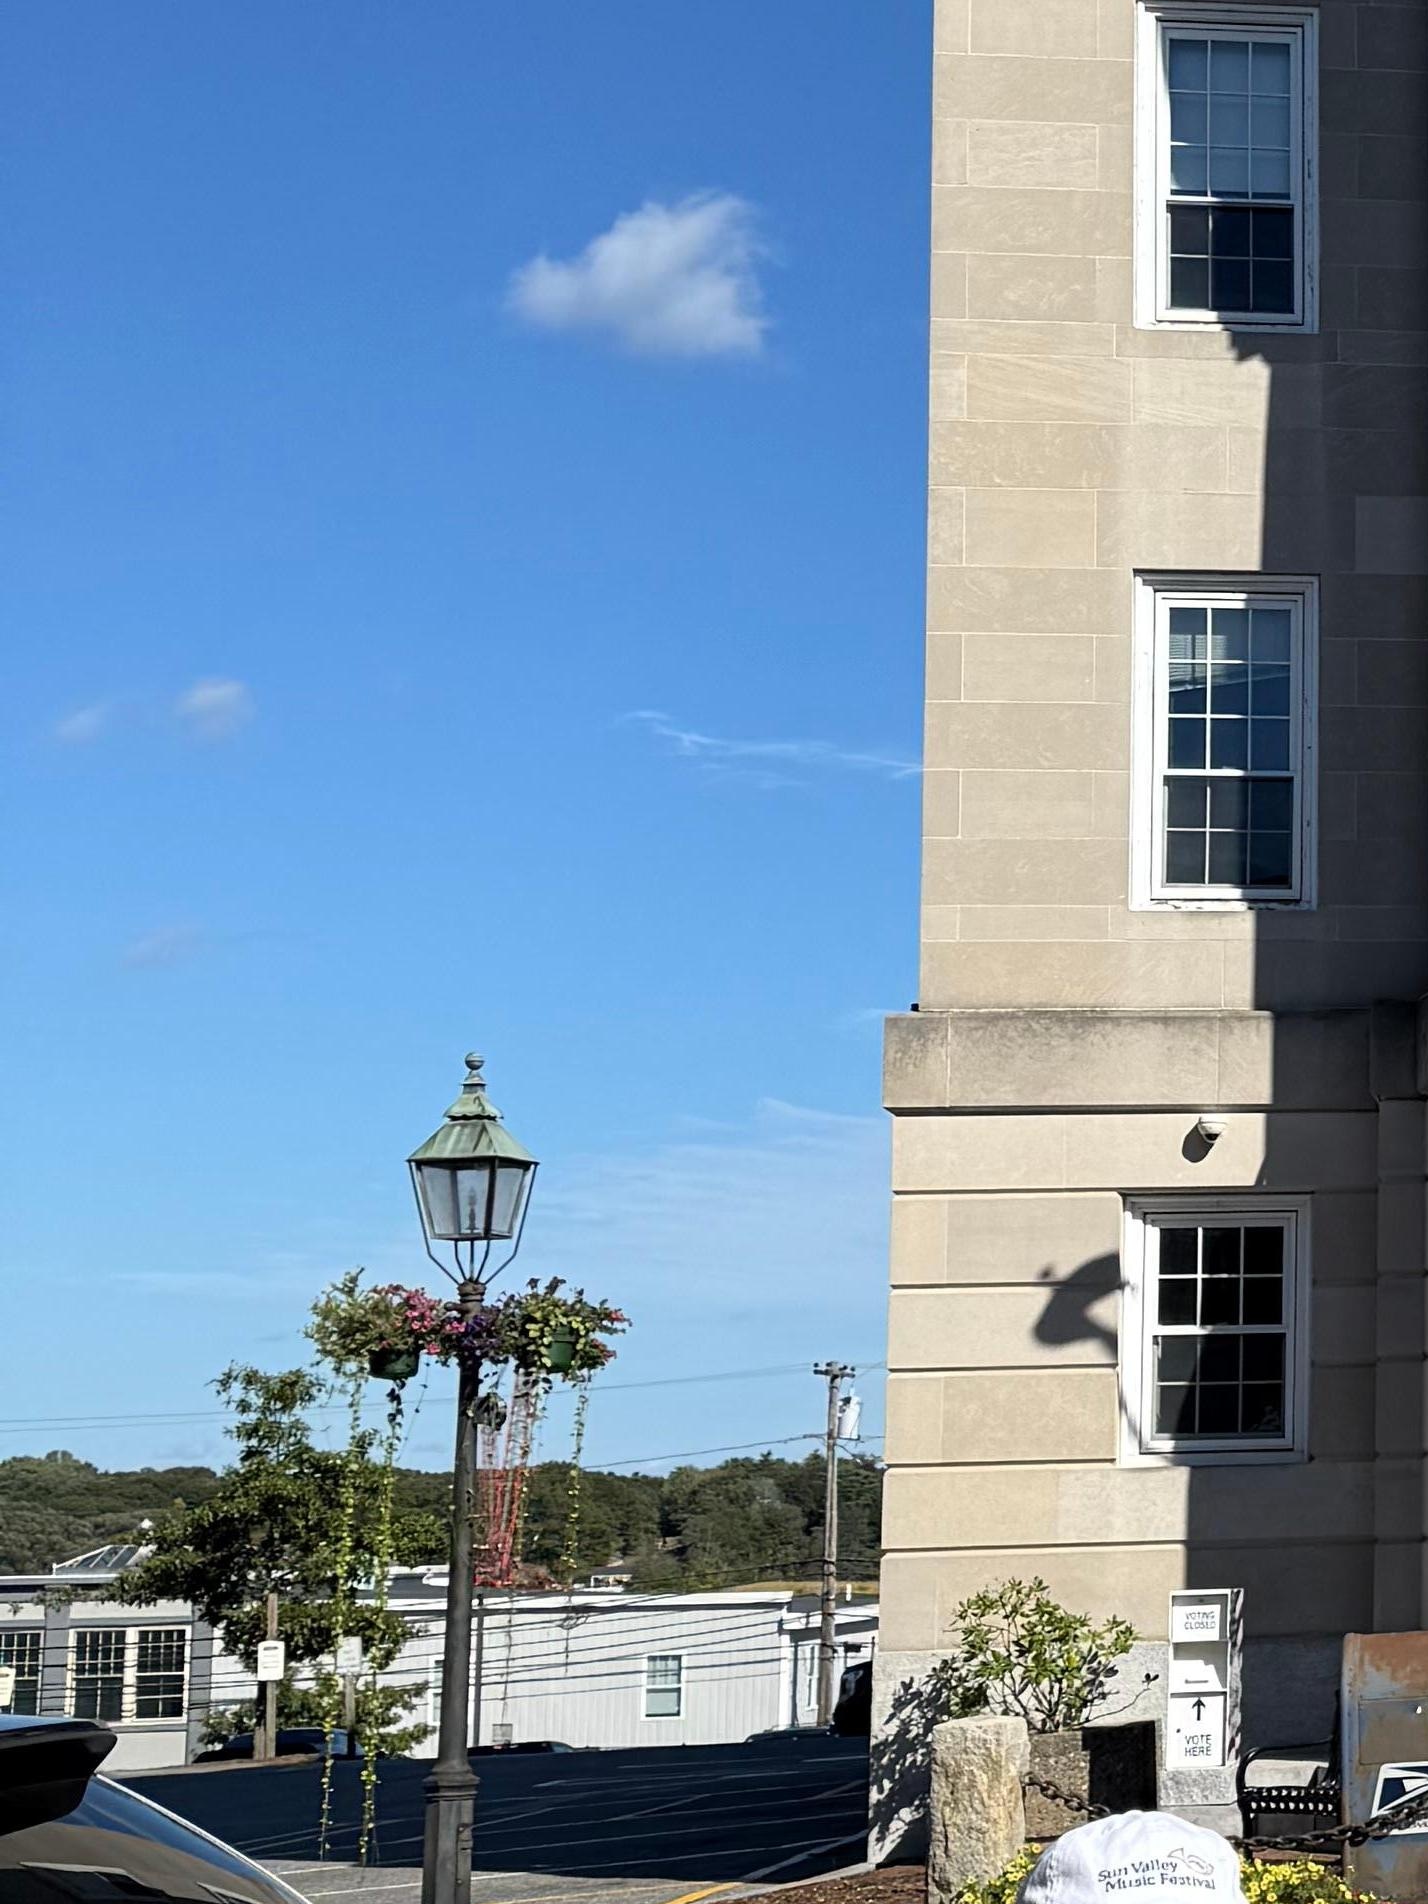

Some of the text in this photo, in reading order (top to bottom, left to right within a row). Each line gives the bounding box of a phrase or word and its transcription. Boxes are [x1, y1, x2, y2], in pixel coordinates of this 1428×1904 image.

[1185, 1610, 1216, 1621] VOTING
[1184, 1621, 1217, 1631] CLOSED
[1184, 1734, 1212, 1746] VOTE
[1184, 1746, 1212, 1757] HERE
[1098, 1858, 1178, 1883] Sun Valley
[1105, 1873, 1216, 1893] Music Festival
